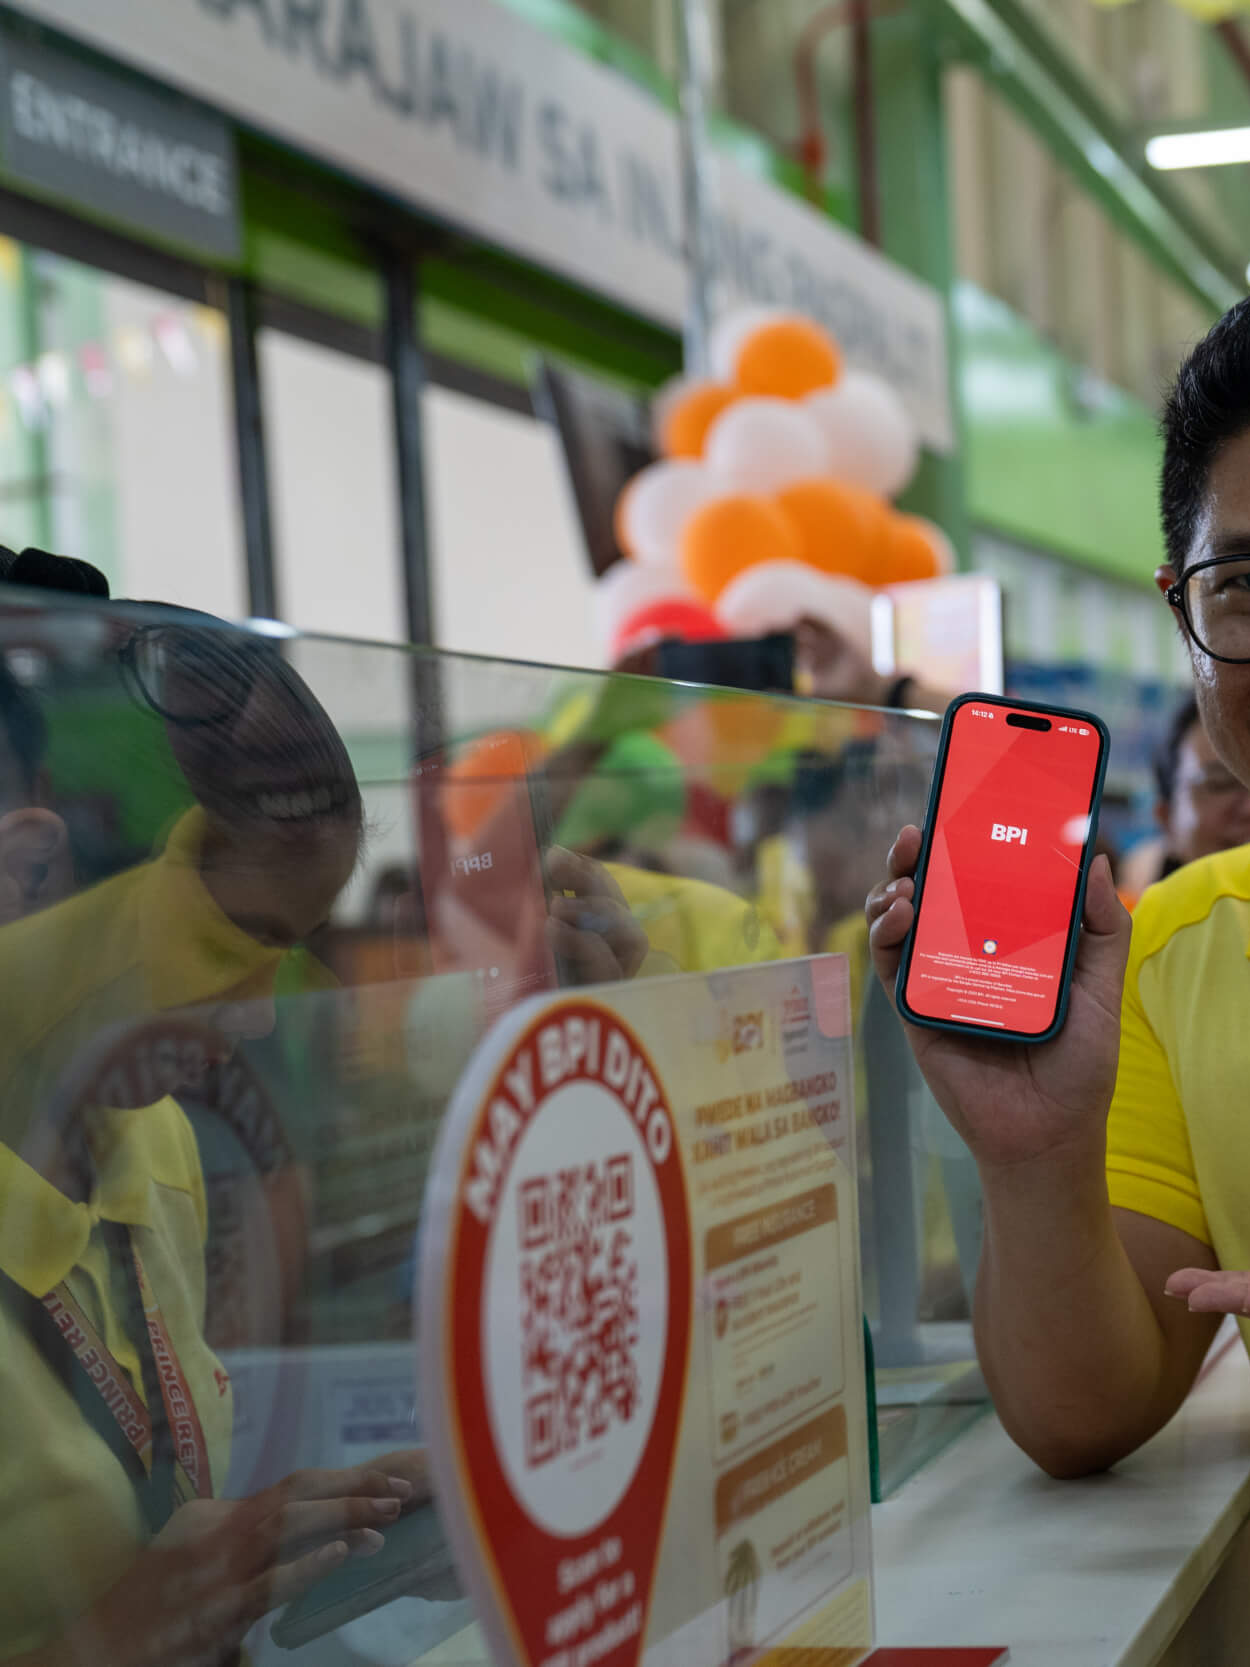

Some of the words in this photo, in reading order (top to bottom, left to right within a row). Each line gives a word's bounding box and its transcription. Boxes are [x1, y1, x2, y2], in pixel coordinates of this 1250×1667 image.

[11, 69, 230, 217] ENTRANCE
[990, 823, 1028, 846] BPI
[466, 1050, 536, 1224] MAY
[537, 1017, 601, 1088] BPI
[602, 1028, 672, 1166] DITO
[41, 1292, 87, 1349] RET
[79, 1347, 146, 1442] PRINCE
[147, 1320, 190, 1419] PRINCE
[175, 1420, 200, 1489] RET
